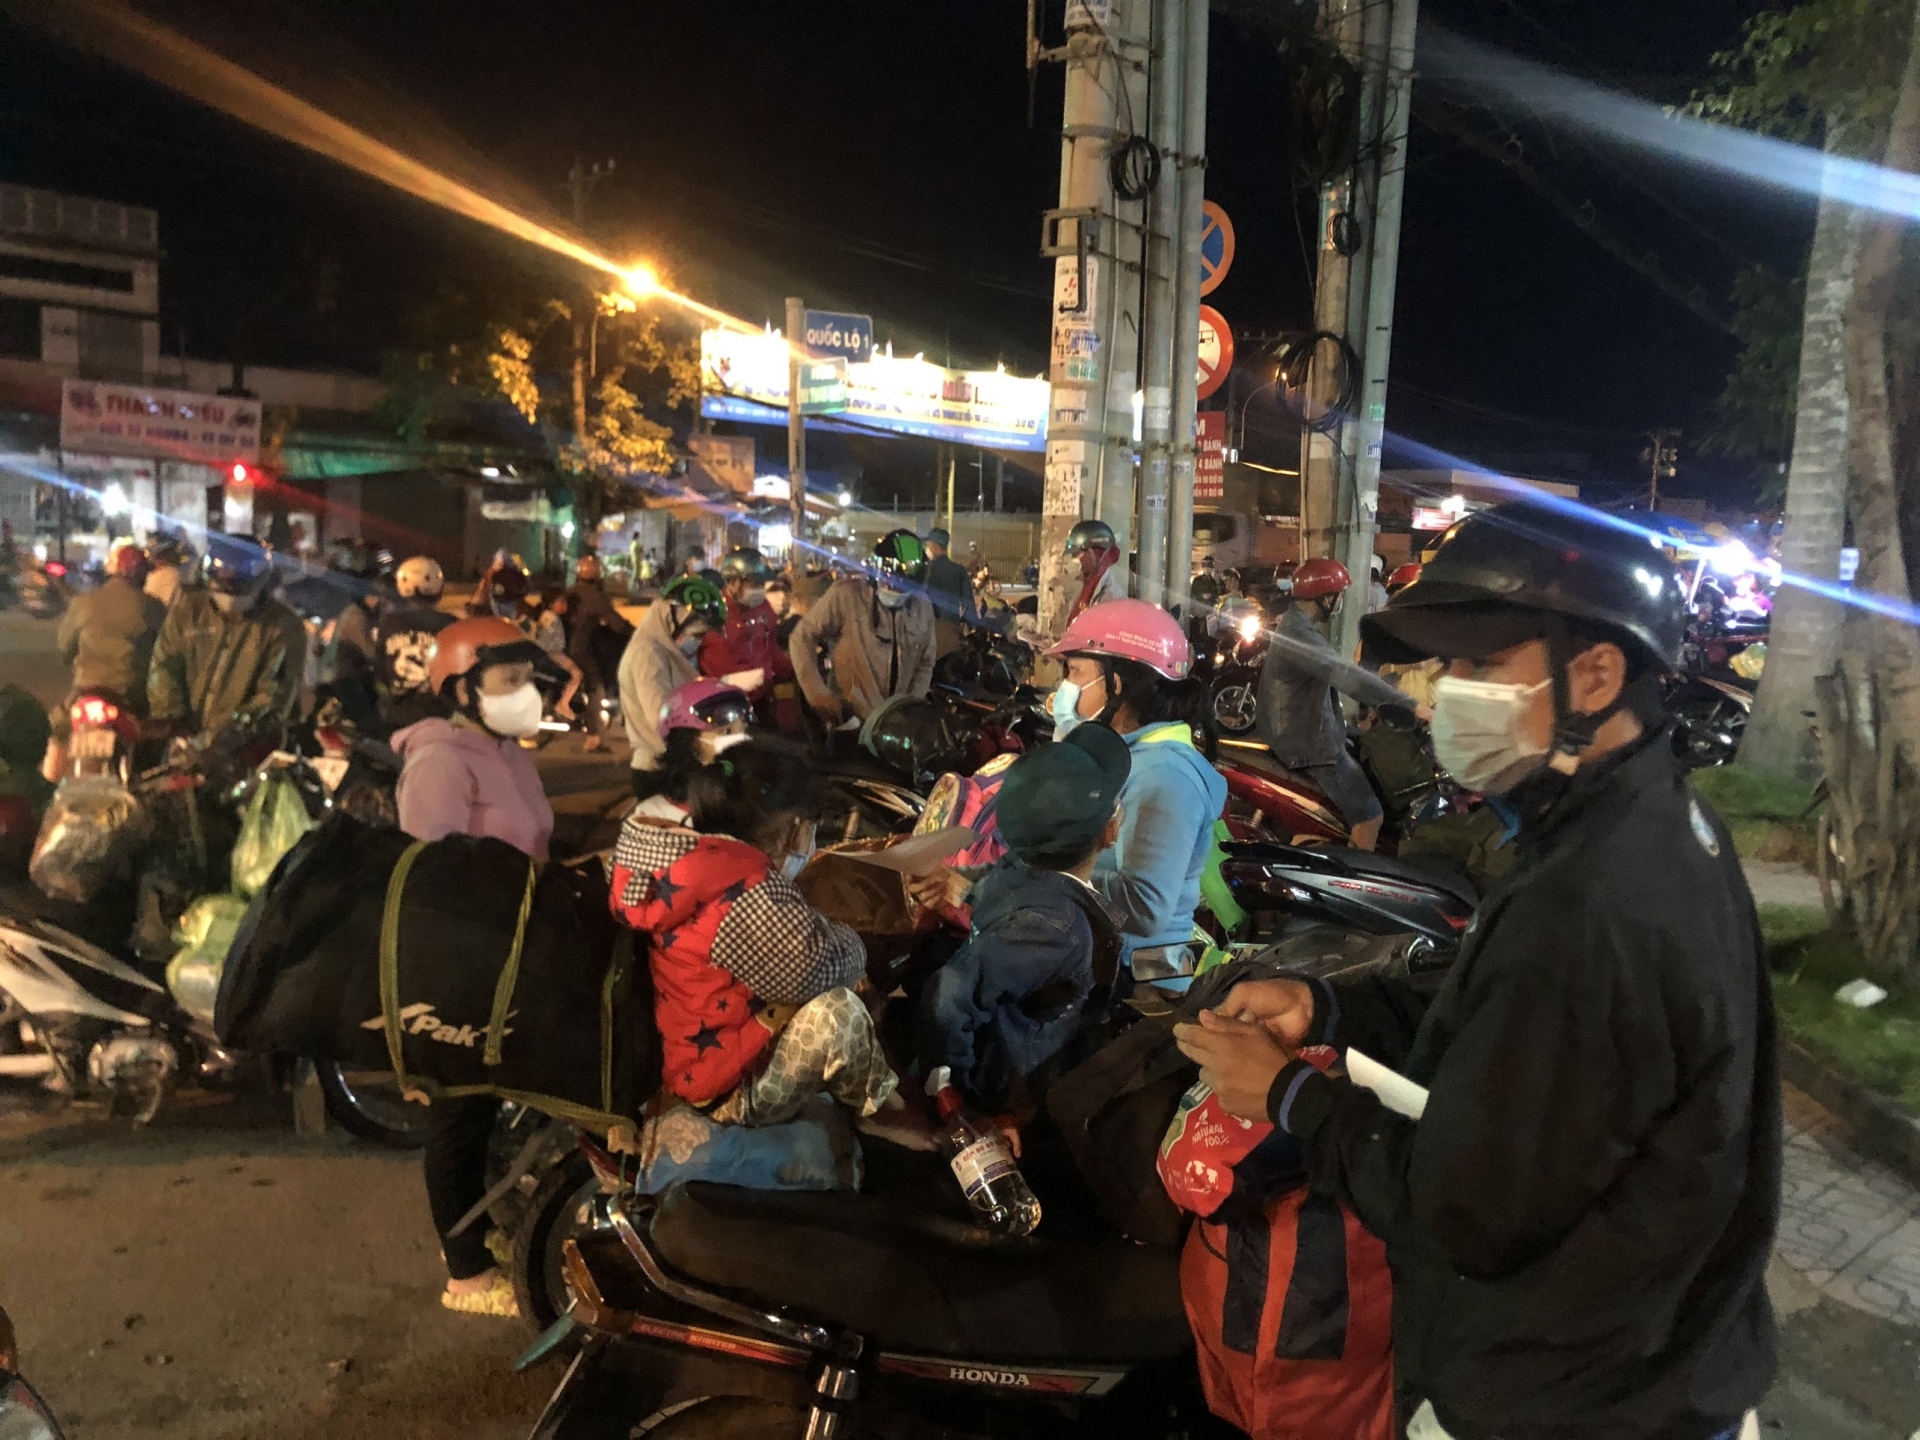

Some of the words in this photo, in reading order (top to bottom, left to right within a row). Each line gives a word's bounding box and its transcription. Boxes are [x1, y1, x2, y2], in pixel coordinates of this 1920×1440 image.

[807, 322, 842, 348] QUỐC
[844, 327, 860, 354] LỘ
[863, 334, 869, 349] 1
[1203, 436, 1222, 452] BÁNH
[1204, 454, 1223, 471] BÁNH
[1192, 1124, 1225, 1145] NATURAL
[1204, 1134, 1230, 1148] 100%
[949, 1367, 1031, 1386] HONDA
